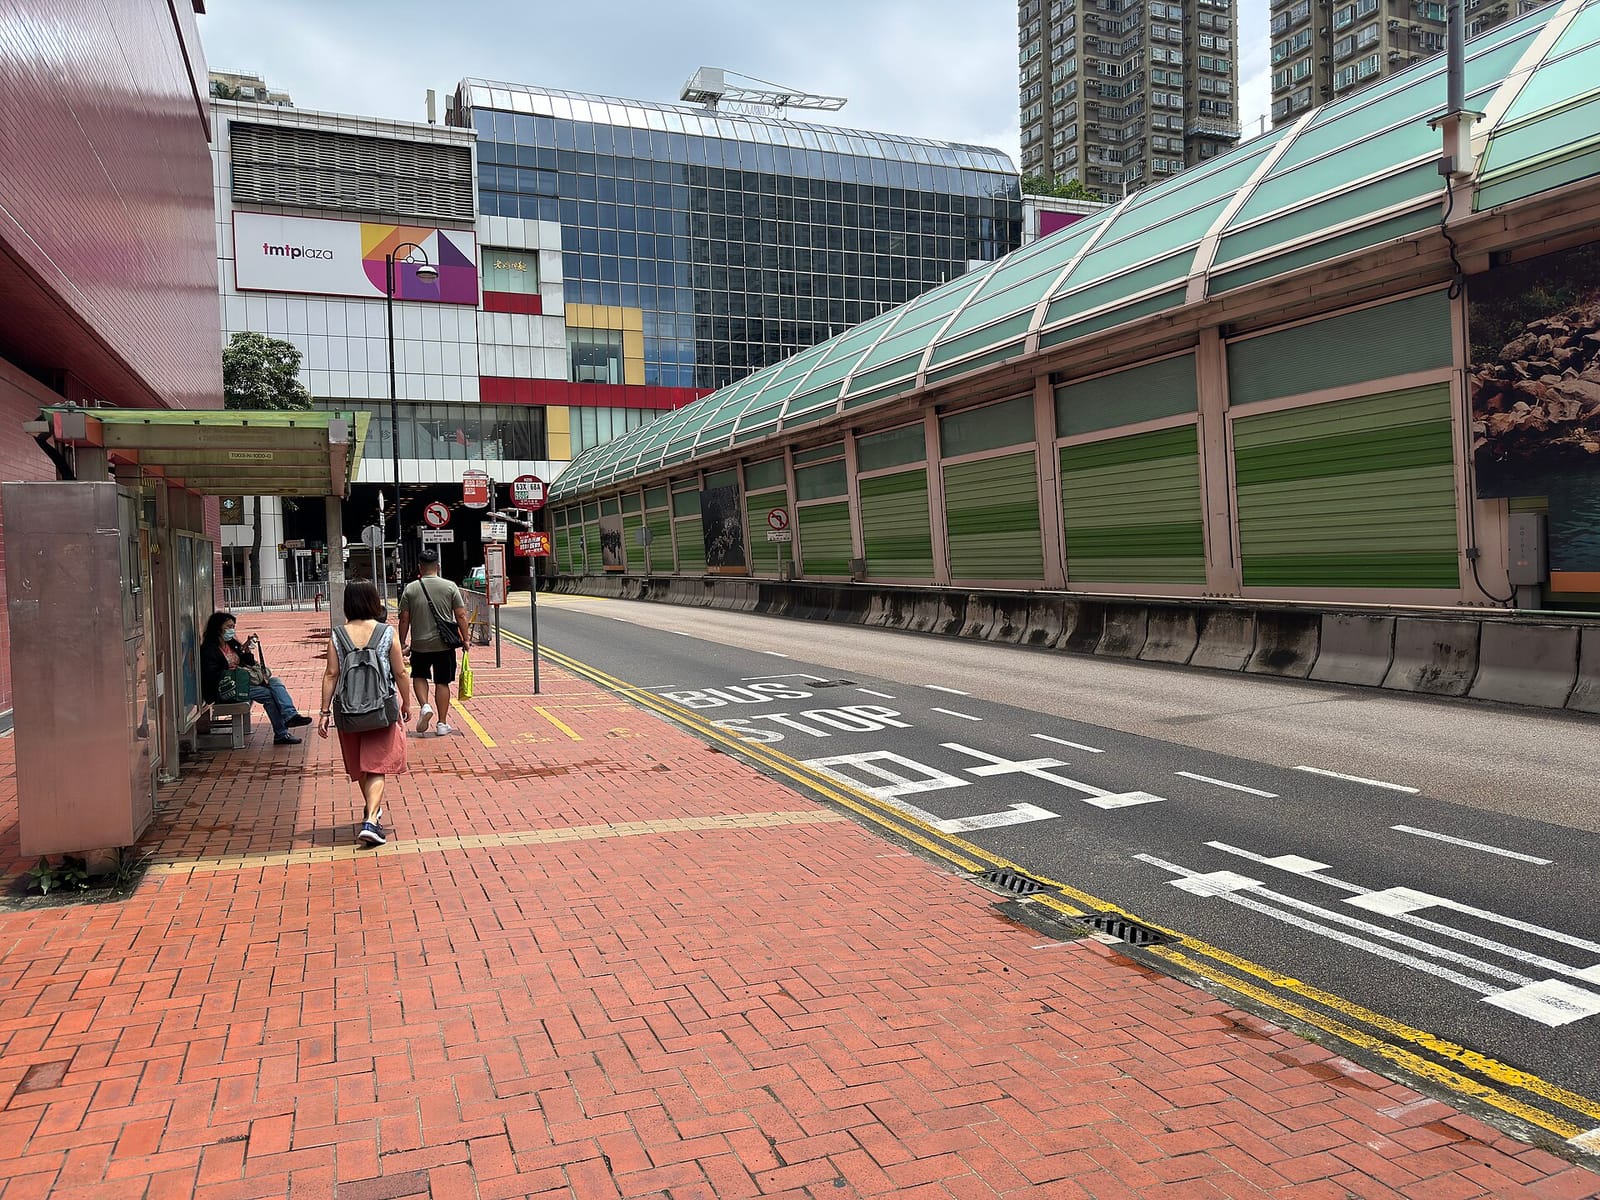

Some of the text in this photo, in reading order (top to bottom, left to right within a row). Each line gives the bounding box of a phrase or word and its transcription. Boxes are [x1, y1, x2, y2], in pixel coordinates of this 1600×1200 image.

[263, 243, 333, 260] tmtplaza
[658, 683, 814, 709] BUS
[710, 704, 913, 744] STOP
